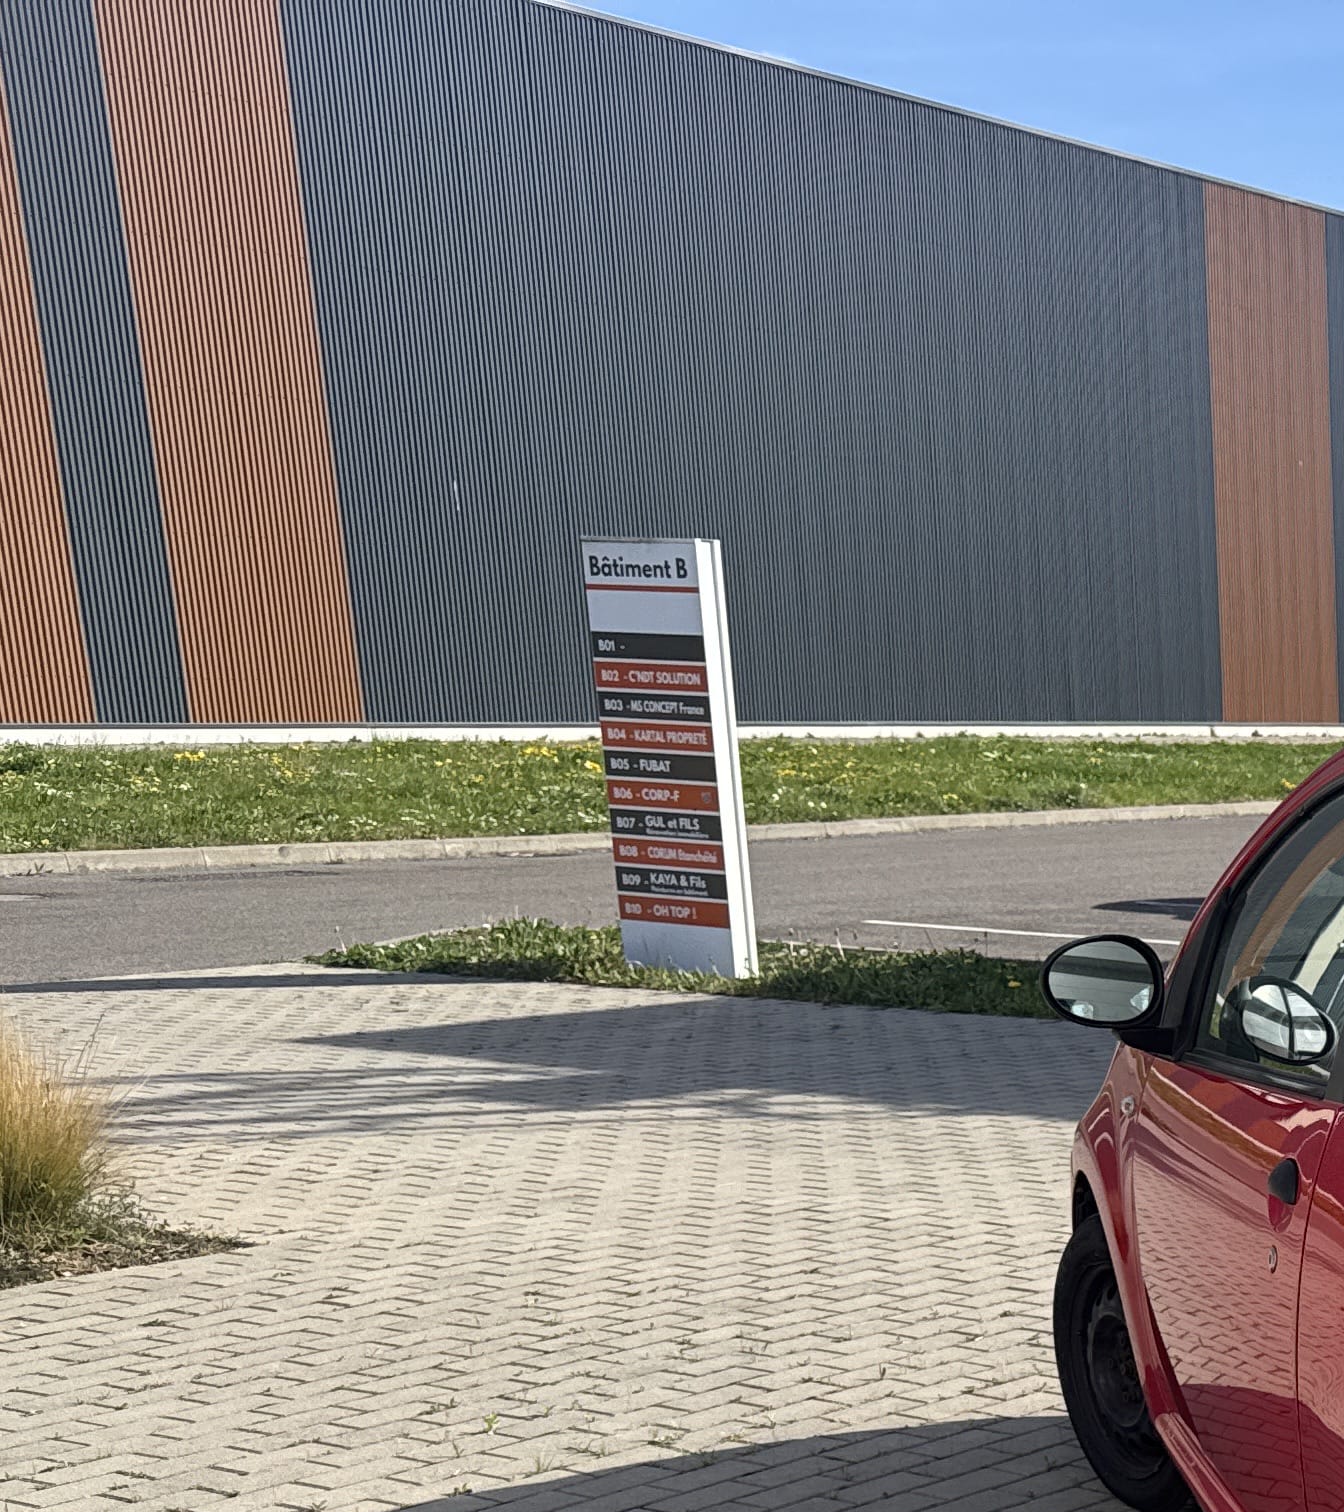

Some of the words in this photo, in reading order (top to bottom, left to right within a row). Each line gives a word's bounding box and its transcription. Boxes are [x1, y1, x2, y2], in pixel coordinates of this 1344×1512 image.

[588, 555, 672, 579] Bâtiment
[675, 557, 688, 579] B
[598, 639, 615, 651] B01
[601, 669, 619, 682] B02
[656, 671, 701, 685] SOLUTION
[604, 699, 623, 711] B03
[644, 701, 678, 714] CONCEPT
[607, 728, 626, 740] B04
[634, 729, 666, 743] KARTAL
[610, 757, 630, 770] B05
[640, 759, 671, 772] FUBAT
[613, 787, 633, 799] B06
[616, 816, 635, 828] B07
[645, 815, 665, 829] GUL
[667, 818, 677, 829] et
[679, 817, 700, 830] FILS
[622, 874, 641, 885] B09
[650, 872, 678, 886] KAYA
[680, 874, 688, 888] &
[689, 876, 707, 889] Fils
[653, 905, 670, 917] OH
[671, 906, 690, 918] TOP
